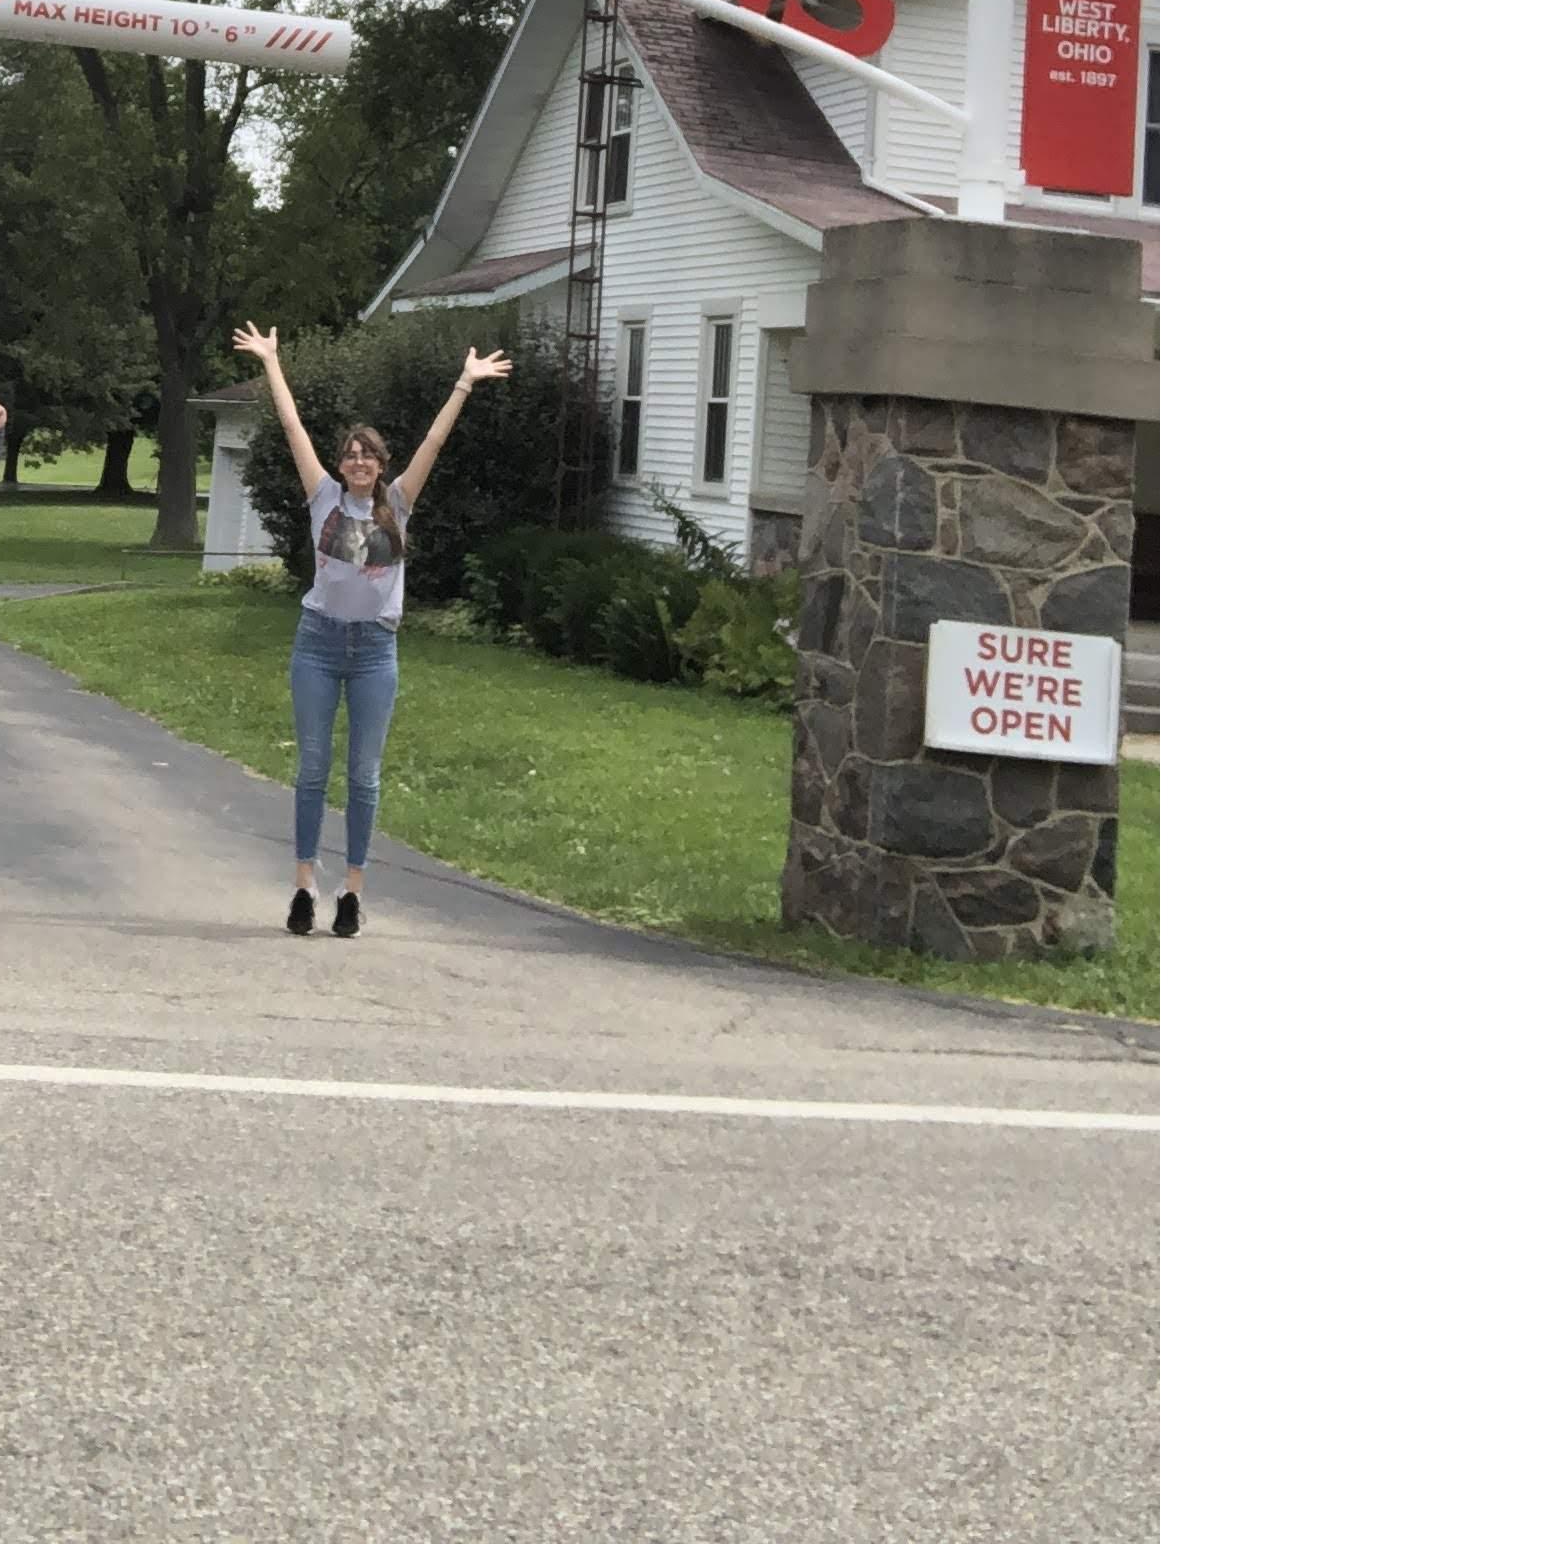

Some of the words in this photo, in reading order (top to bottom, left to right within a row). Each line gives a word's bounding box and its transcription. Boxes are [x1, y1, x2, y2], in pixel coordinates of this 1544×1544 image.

[13, 0, 65, 22] MAX
[73, 7, 163, 33] HEIGHT
[1057, 40, 1113, 64] OHIO
[1079, 70, 1117, 88] 1897
[977, 631, 1073, 669] SURE
[964, 667, 1083, 707] WE'RE
[970, 706, 1073, 743] OPEN
